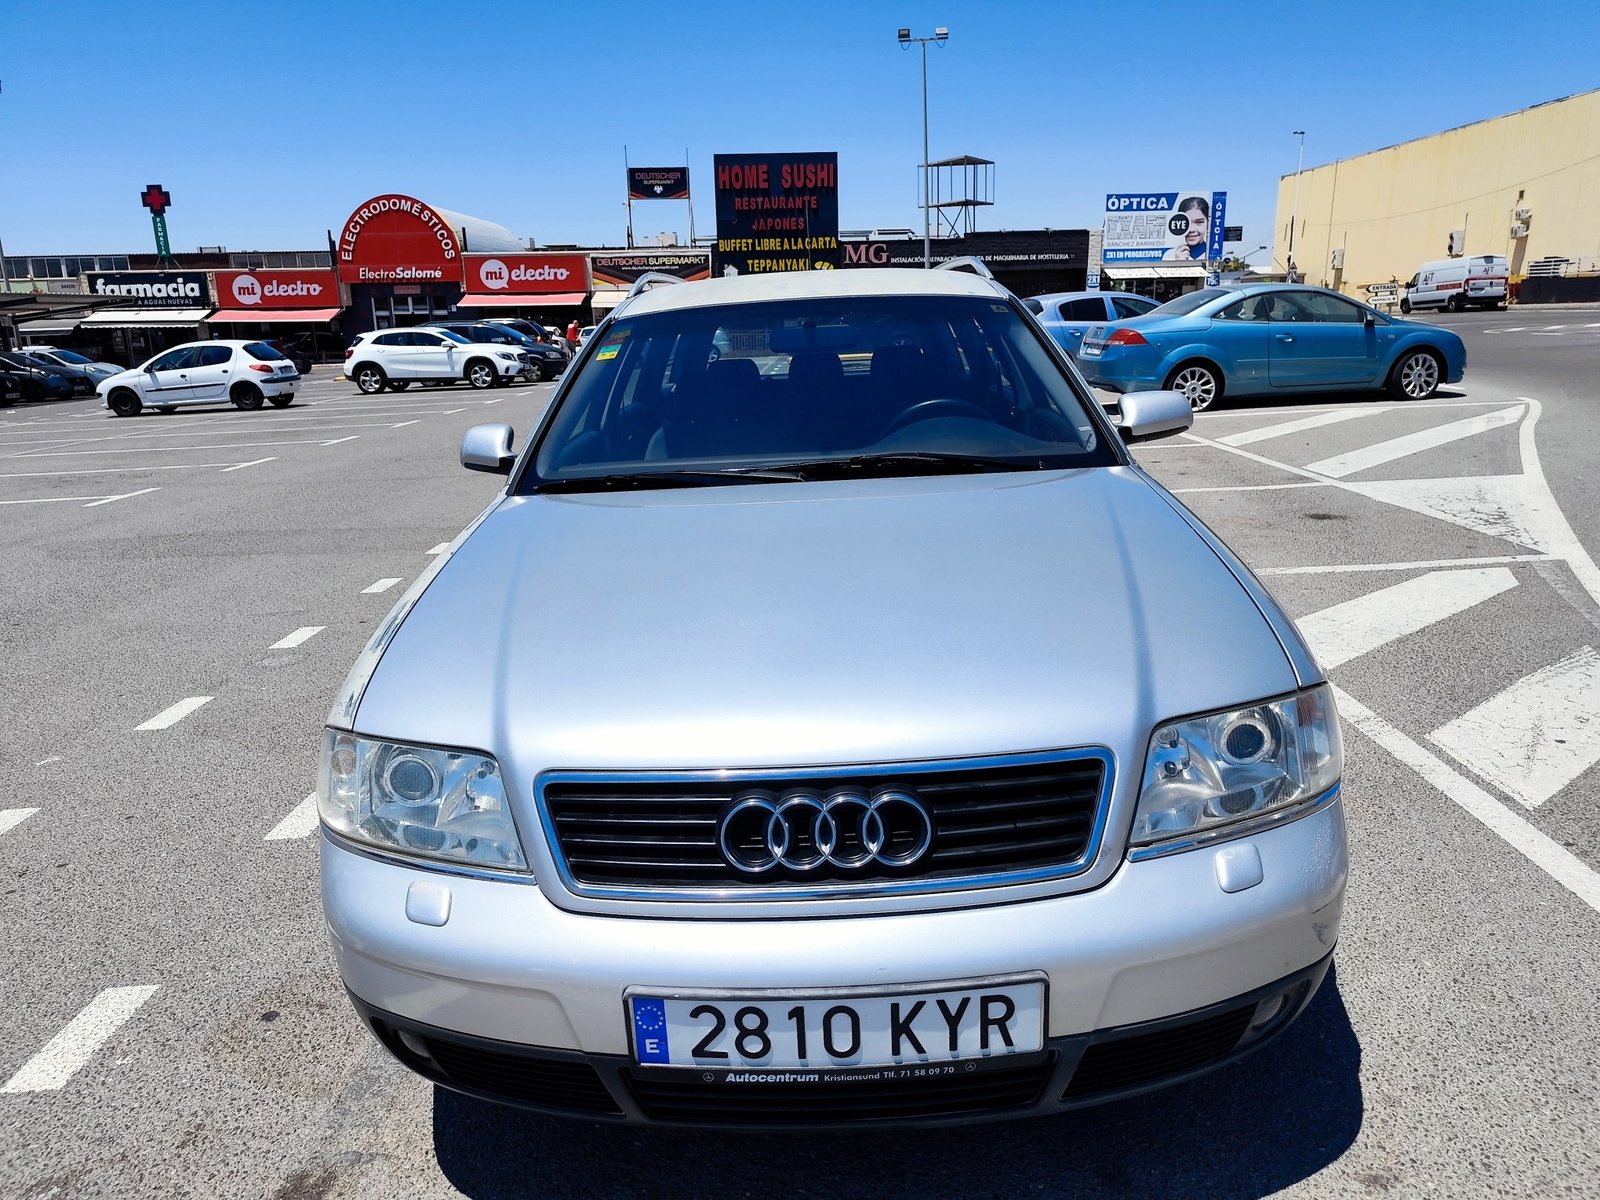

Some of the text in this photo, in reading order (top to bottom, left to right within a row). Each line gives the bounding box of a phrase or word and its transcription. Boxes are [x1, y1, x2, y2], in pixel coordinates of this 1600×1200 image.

[635, 172, 680, 180] DEUTSCHER
[718, 163, 834, 189] HOME SUSHI
[735, 196, 818, 210] RESTAURANTE
[1107, 196, 1169, 210] ÓPTICA
[341, 198, 456, 261] ELECTRODOMÉSTICOS
[752, 217, 805, 231] JAPONES
[1171, 222, 1187, 230] EYE
[156, 217, 167, 255] FARMACIA
[719, 237, 837, 252] BUFFET LIBRE A LA CARTA
[596, 256, 706, 266] DEUTSCHER SUPERMARKT
[843, 243, 890, 264] MG
[1124, 249, 1163, 258] PROGRESIVOS
[359, 266, 442, 279] ElectroSalomé
[485, 264, 570, 281] mi electro
[747, 258, 809, 272] TEPPANYAKI
[95, 277, 200, 297] farmacia
[237, 280, 323, 296] mi electro
[689, 994, 1015, 1059] 2810 KYR
[645, 1038, 660, 1053] E
[725, 1072, 819, 1083] Autocentrum
[824, 1072, 880, 1082] Kristiansund
[883, 1070, 897, 1079] Tlf.
[914, 1069, 926, 1077] 58
[928, 1067, 940, 1076] 09
[943, 1066, 955, 1075] 70
